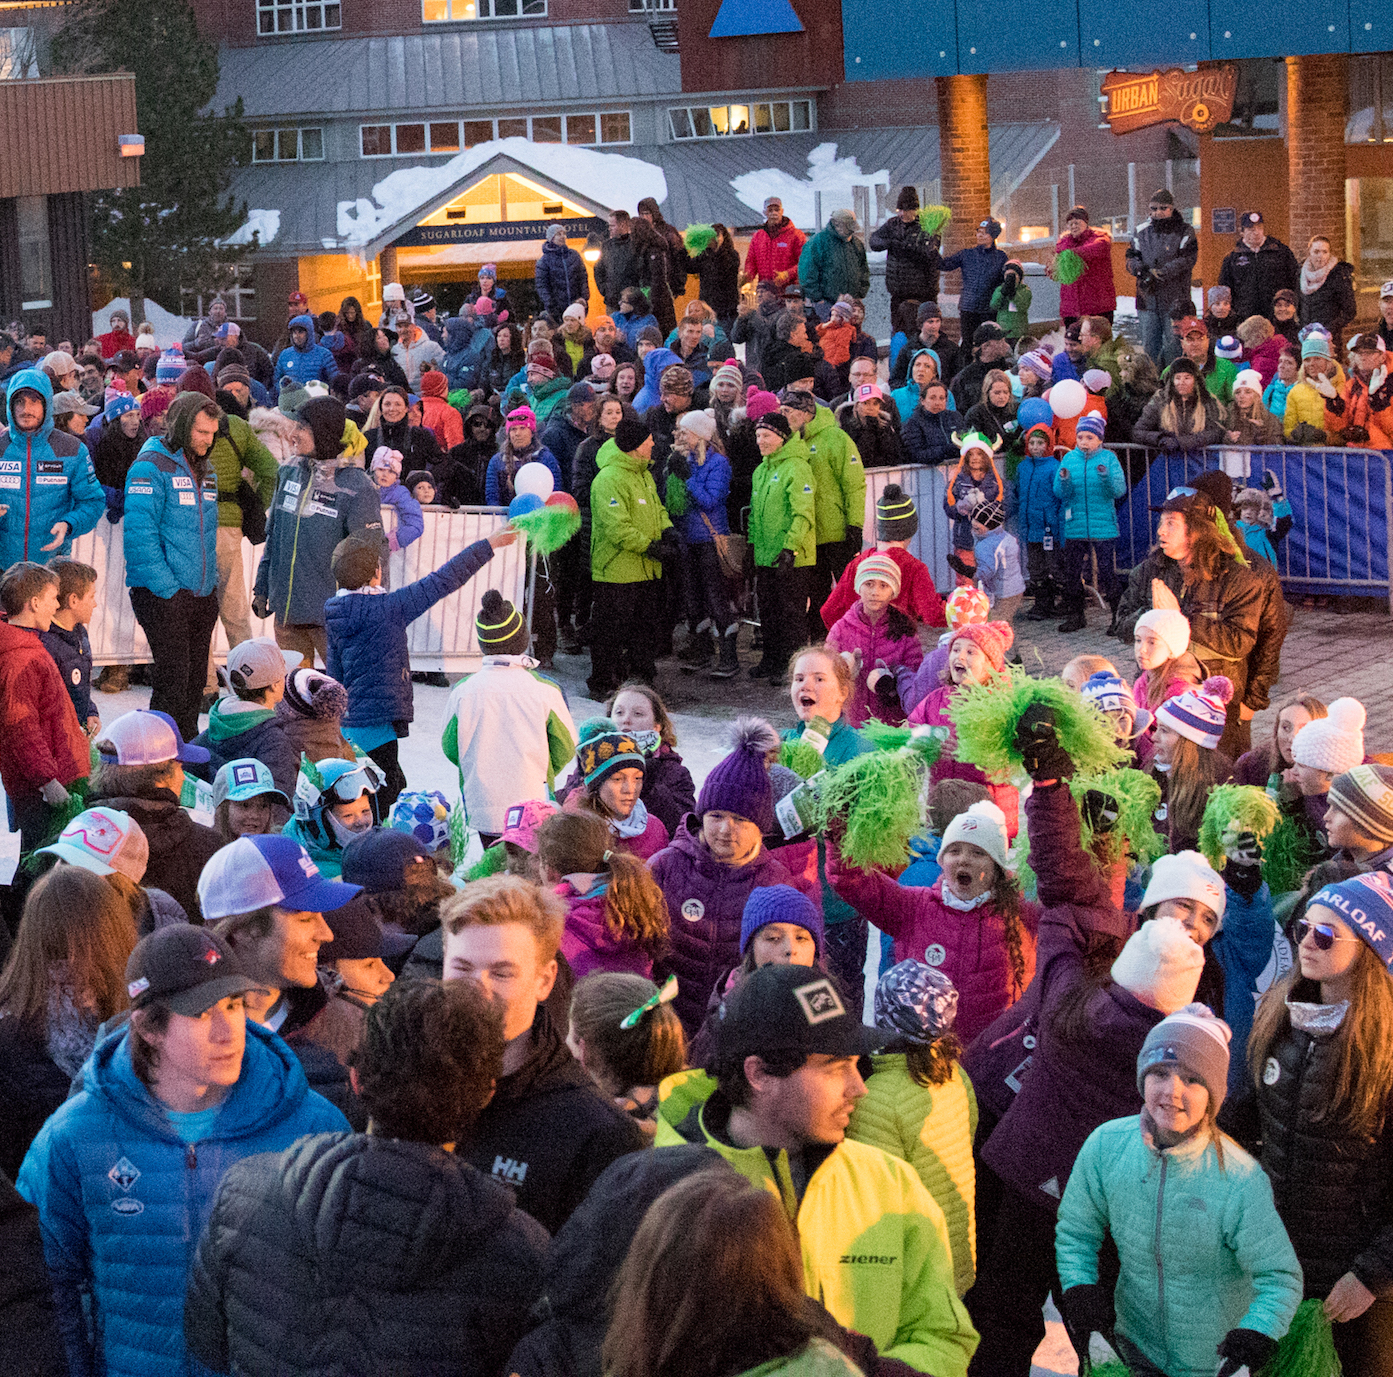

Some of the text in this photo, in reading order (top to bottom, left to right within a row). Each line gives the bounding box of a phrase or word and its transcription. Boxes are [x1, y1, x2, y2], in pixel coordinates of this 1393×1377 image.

[1111, 81, 1158, 113] URBAN
[420, 229, 485, 241] SUGARLOAF
[564, 222, 590, 233] OTEL
[174, 478, 192, 487] VISA
[1313, 889, 1387, 942] ARLOAF
[838, 1255, 898, 1265] ziener
